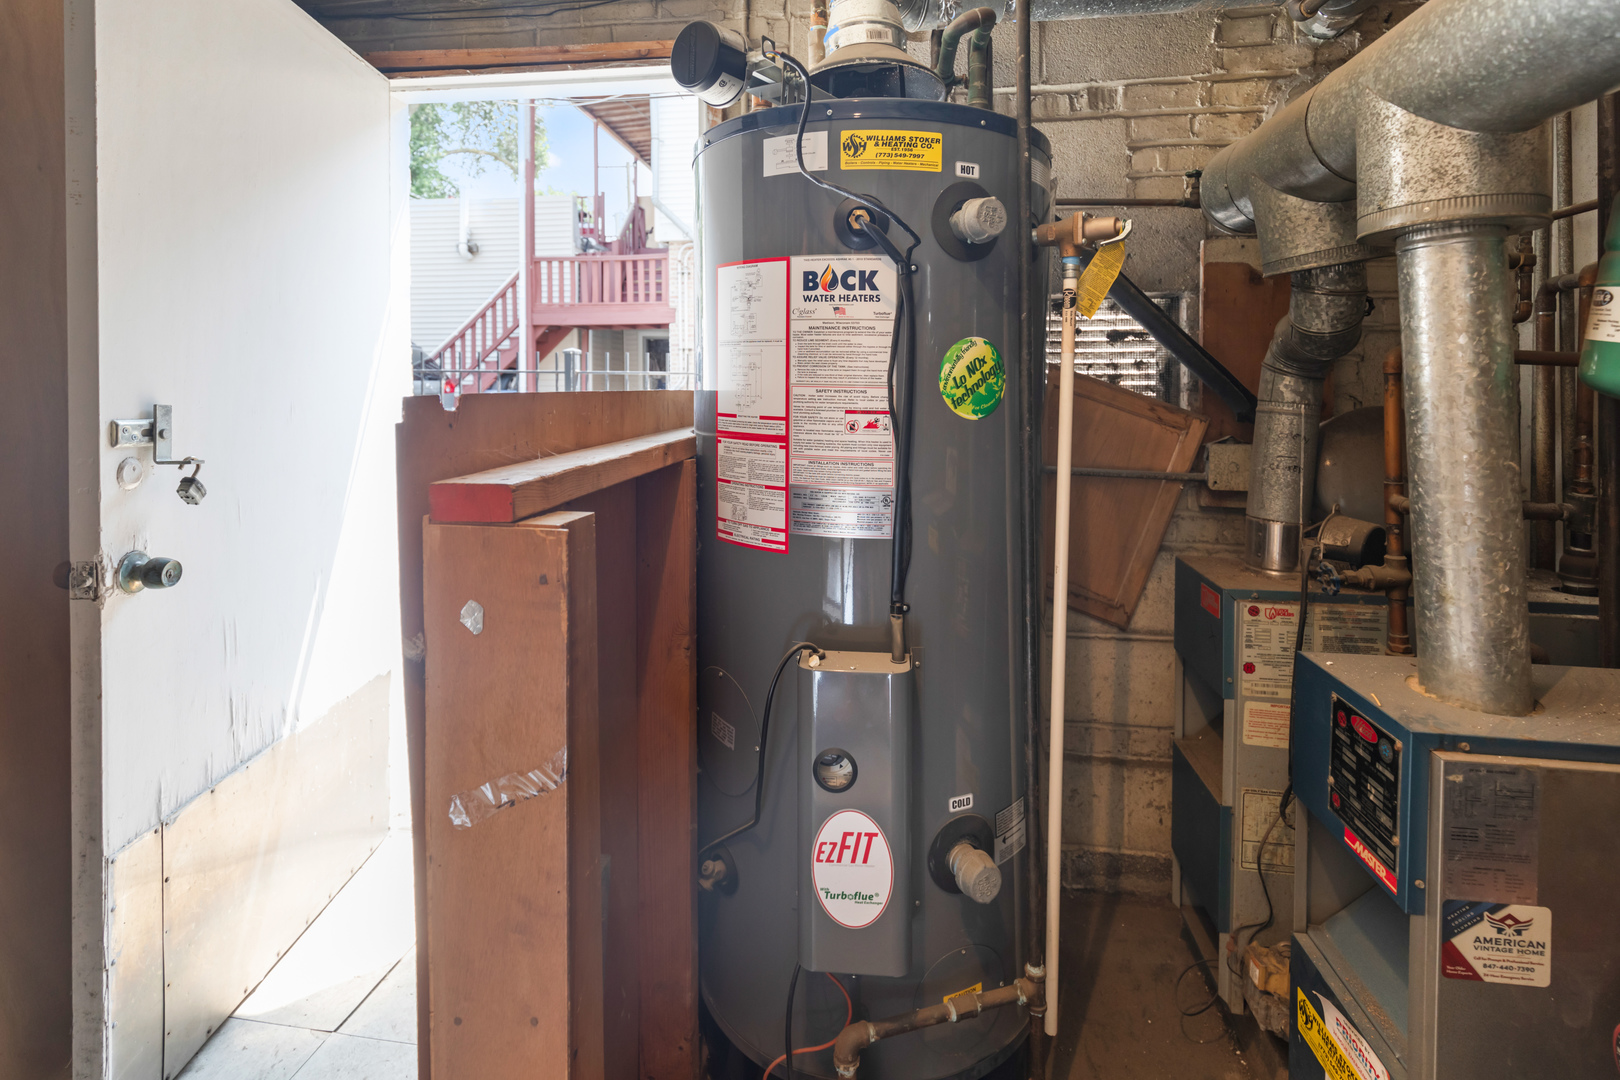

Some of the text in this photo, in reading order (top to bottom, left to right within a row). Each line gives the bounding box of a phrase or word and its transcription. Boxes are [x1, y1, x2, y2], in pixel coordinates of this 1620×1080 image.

[909, 136, 941, 144] STOKER
[960, 164, 975, 175] HOT
[803, 264, 879, 292] BOCK
[803, 294, 881, 303] WATER HEATERS
[952, 355, 987, 389] Lo NOx
[951, 361, 1002, 410] technology
[1355, 717, 1374, 740] Utica
[952, 797, 970, 809] COLD
[1354, 841, 1386, 878] MASTER
[1447, 906, 1470, 920] HEATING
[1452, 912, 1474, 926] COOLING
[1454, 917, 1480, 933] PLUMBING
[1473, 936, 1546, 950] AMERICAN
[1473, 945, 1513, 953] VINTAGE
[1312, 1014, 1338, 1056] WILLIAMS
[1322, 1034, 1345, 1074] HEATING
